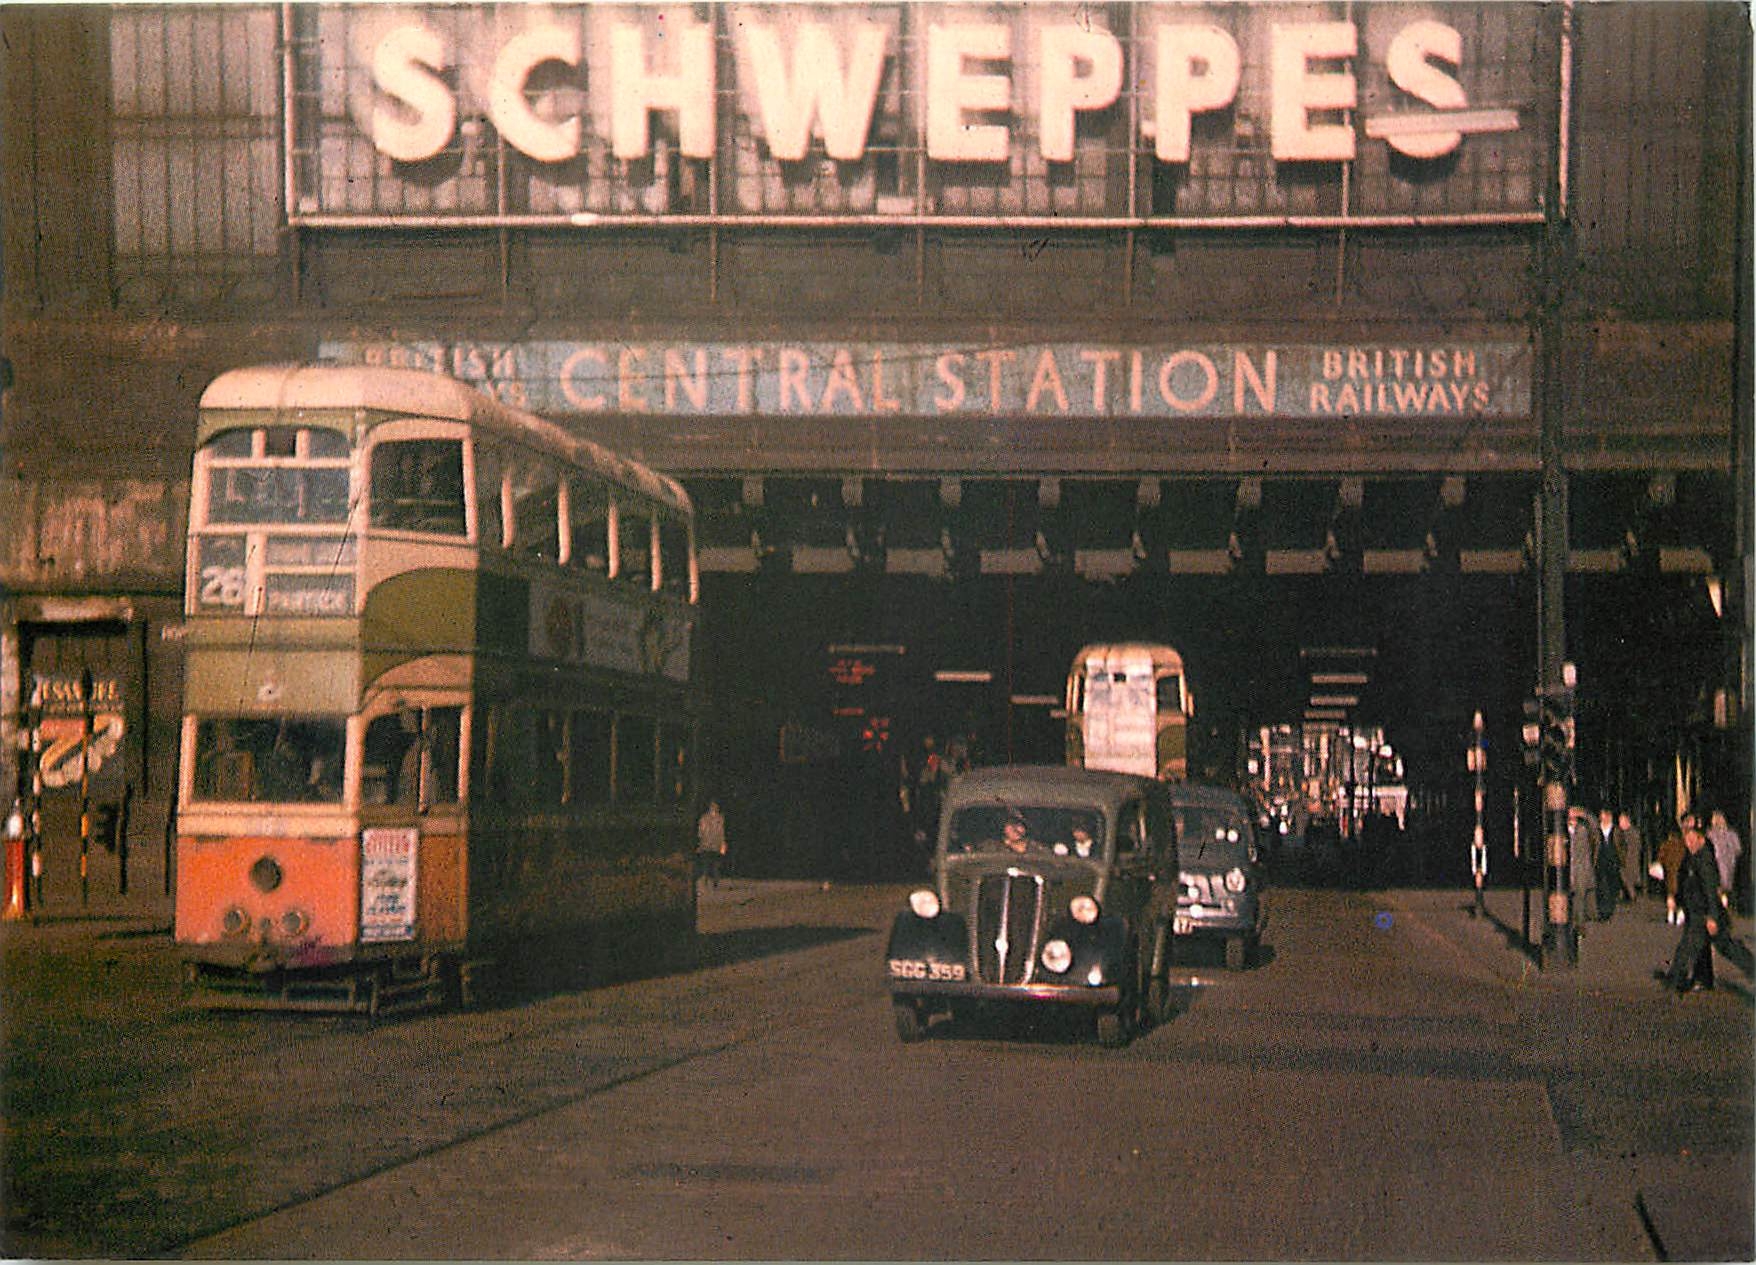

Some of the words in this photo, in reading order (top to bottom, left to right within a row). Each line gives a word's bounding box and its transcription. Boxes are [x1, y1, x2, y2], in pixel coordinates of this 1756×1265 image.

[373, 21, 1467, 163] SCHWEPPES
[559, 346, 900, 413] CENTRAL
[934, 348, 1277, 414] STATION
[1322, 349, 1476, 379] BRITISH
[1309, 381, 1490, 414] RAILWAYS
